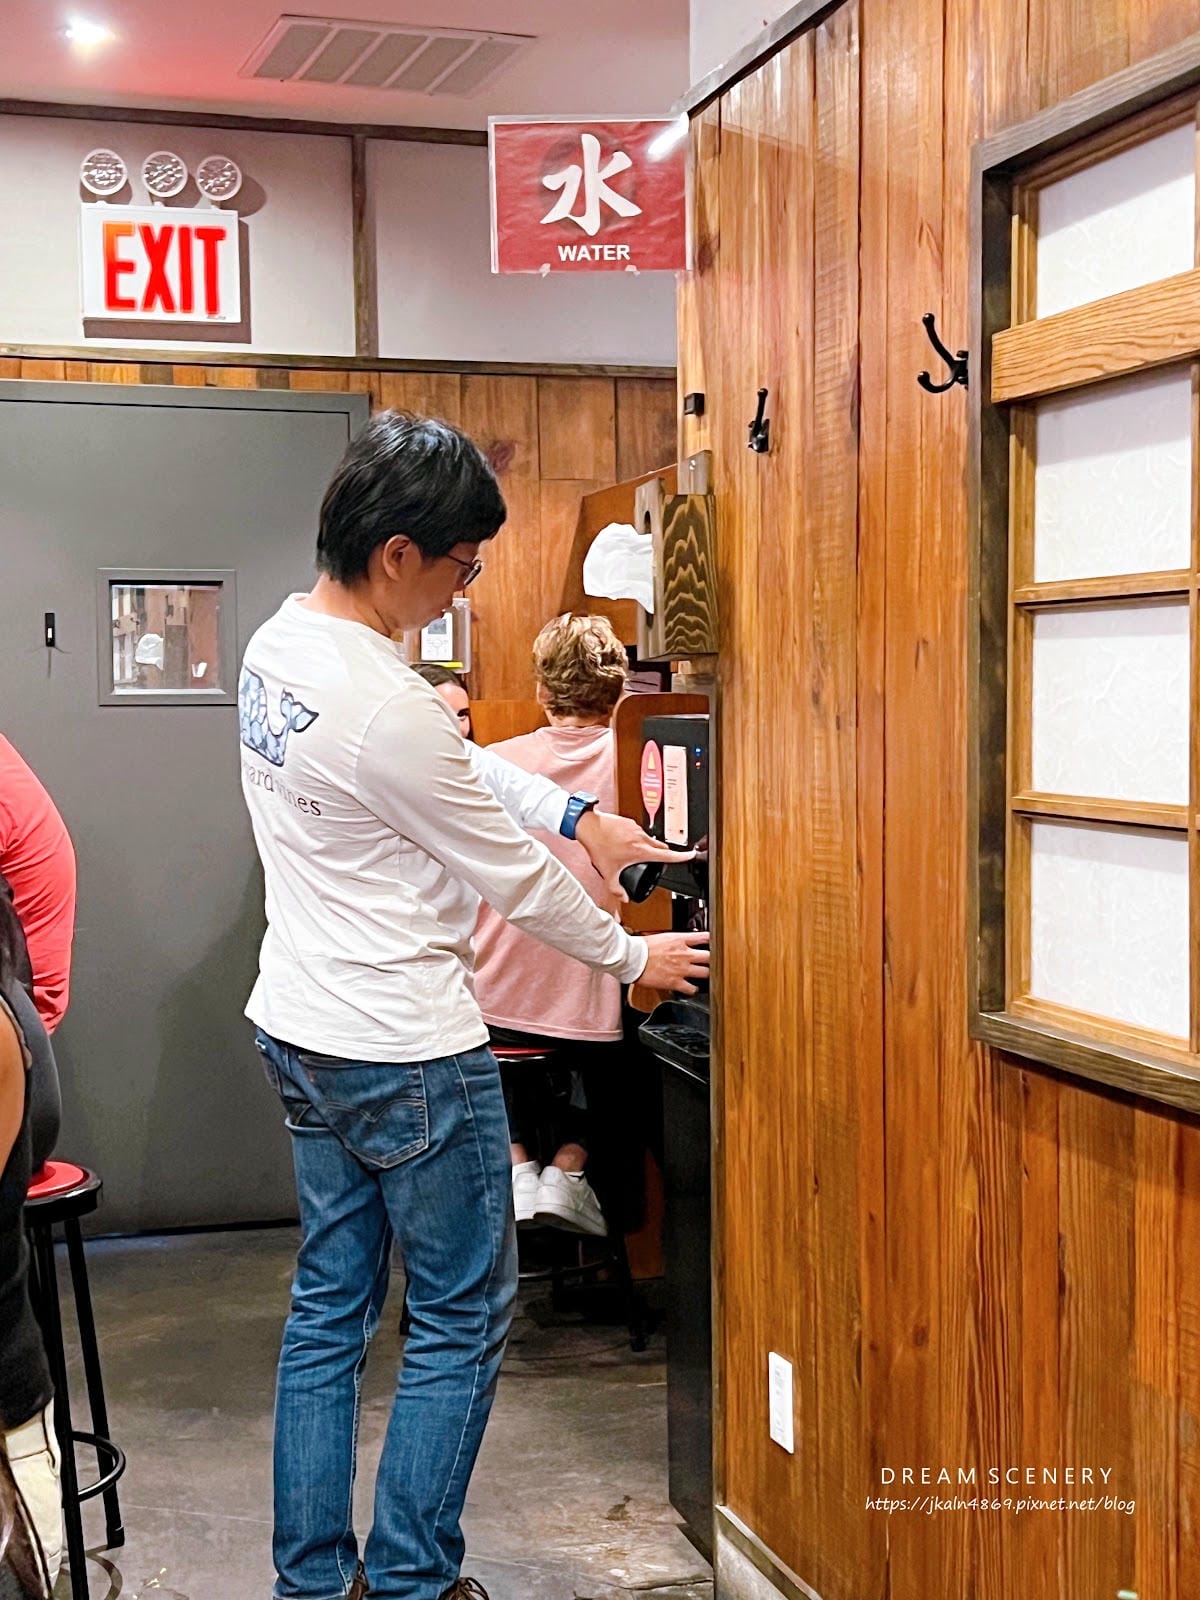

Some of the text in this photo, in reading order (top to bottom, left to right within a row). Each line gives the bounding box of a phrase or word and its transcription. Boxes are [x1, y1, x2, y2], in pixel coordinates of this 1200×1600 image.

[540, 133, 643, 236] 水
[103, 222, 227, 315] EXIT
[557, 244, 631, 262] WATER
